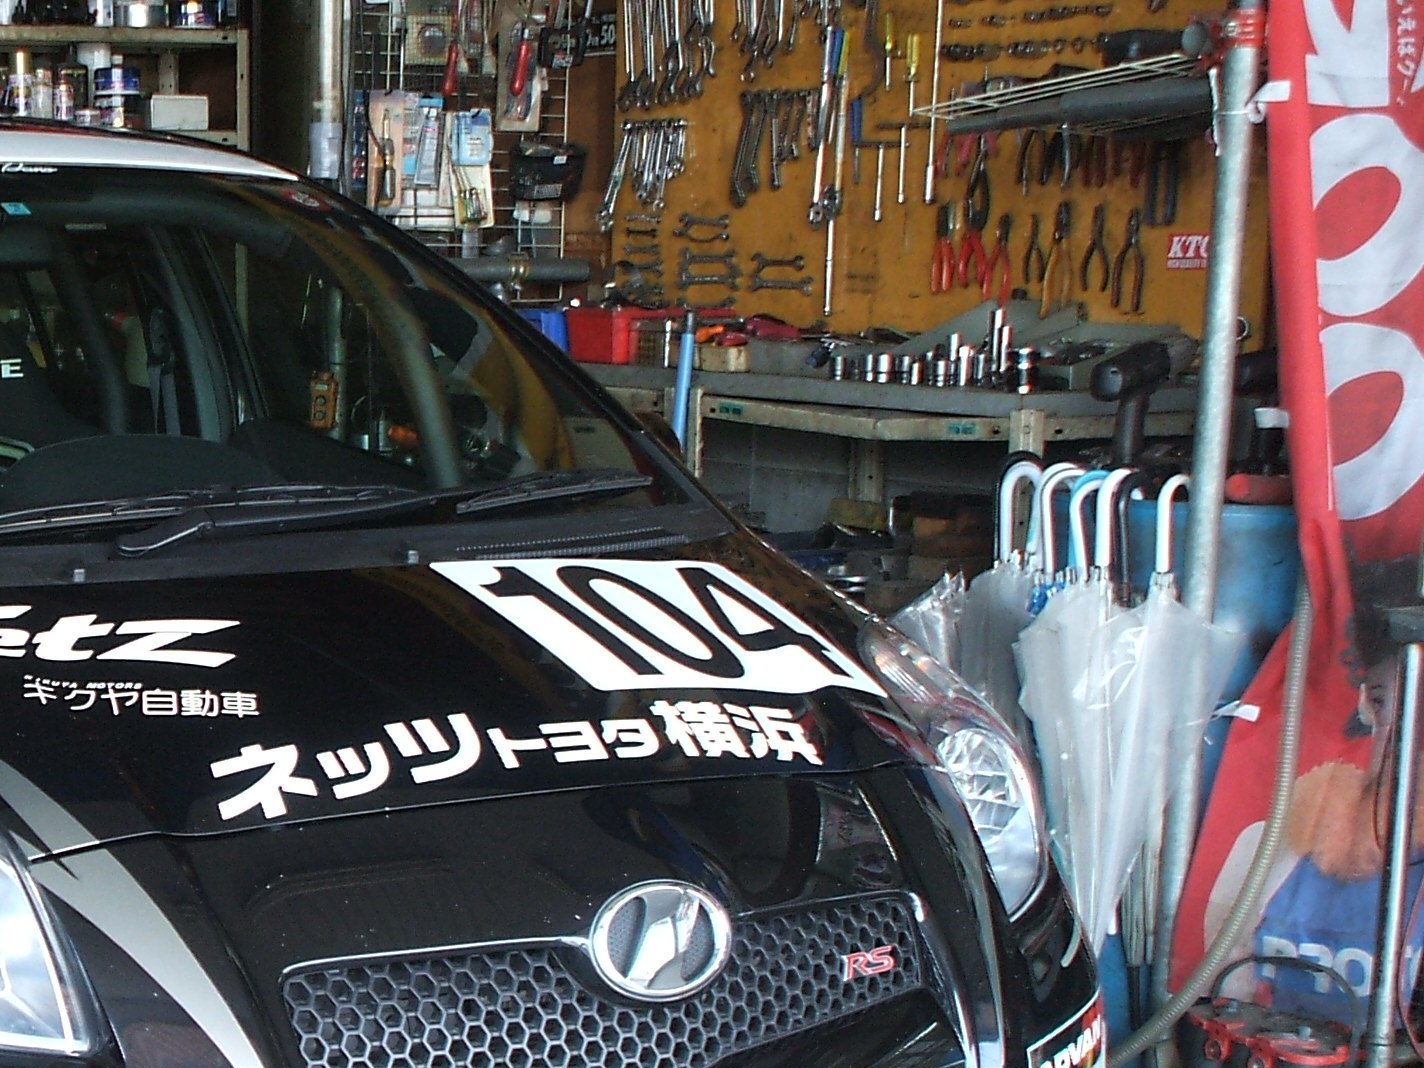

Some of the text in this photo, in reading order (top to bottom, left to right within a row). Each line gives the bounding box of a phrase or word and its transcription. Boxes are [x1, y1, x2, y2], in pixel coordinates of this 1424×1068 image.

[479, 565, 854, 679] 104
[23, 680, 260, 719] キクヤ自動車
[85, 681, 144, 690] MOTORS
[210, 699, 825, 821] ネッツトヨタ横浜
[840, 945, 894, 982] RS
